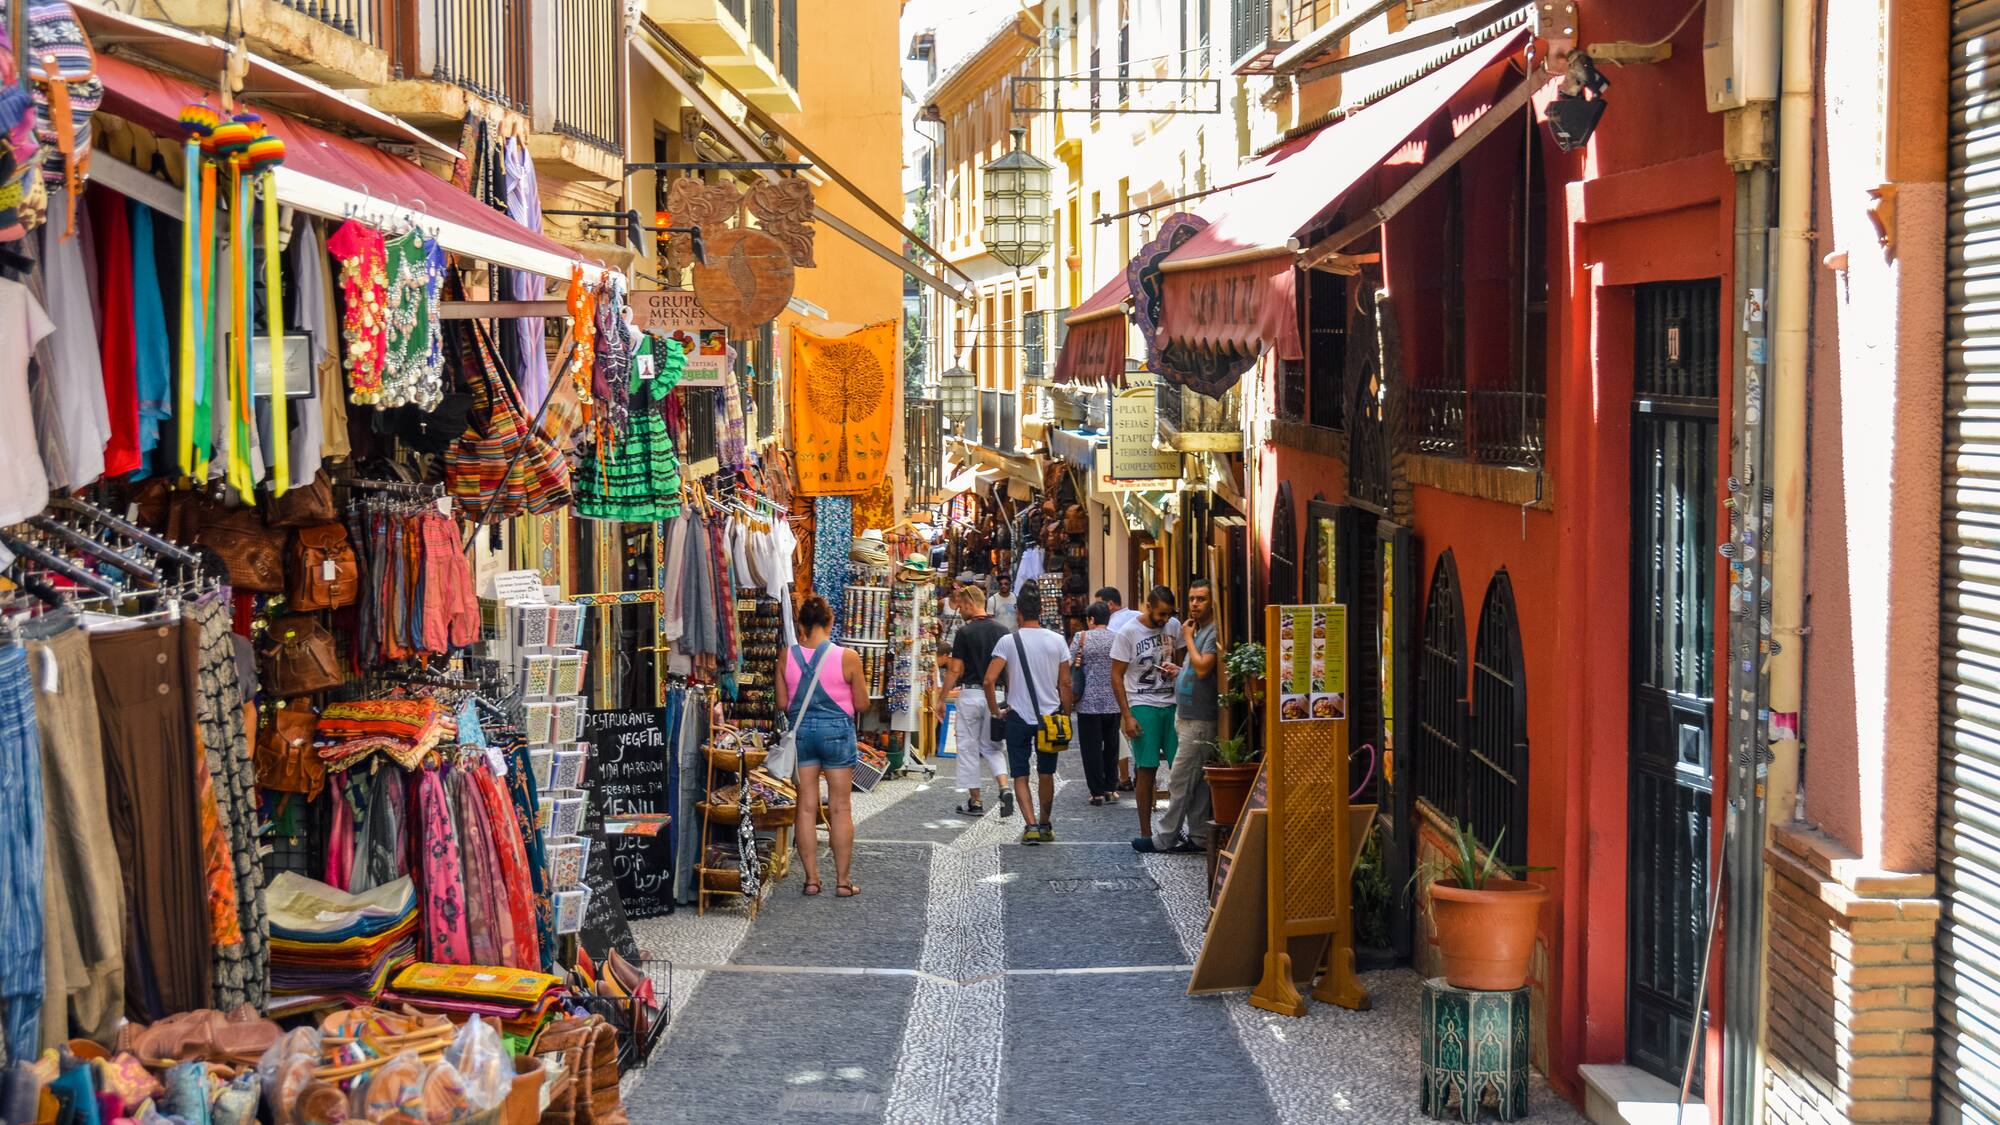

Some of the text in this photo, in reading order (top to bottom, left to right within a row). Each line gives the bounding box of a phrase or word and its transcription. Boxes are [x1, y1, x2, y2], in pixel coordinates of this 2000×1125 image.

[650, 308, 705, 318] MEKNES
[1119, 405, 1148, 414] PLATA
[1119, 419, 1150, 428] SEDAS
[1119, 462, 1177, 471] COMPLEMENTOS
[618, 727, 665, 748] VEGETAL
[616, 835, 650, 851] DEL
